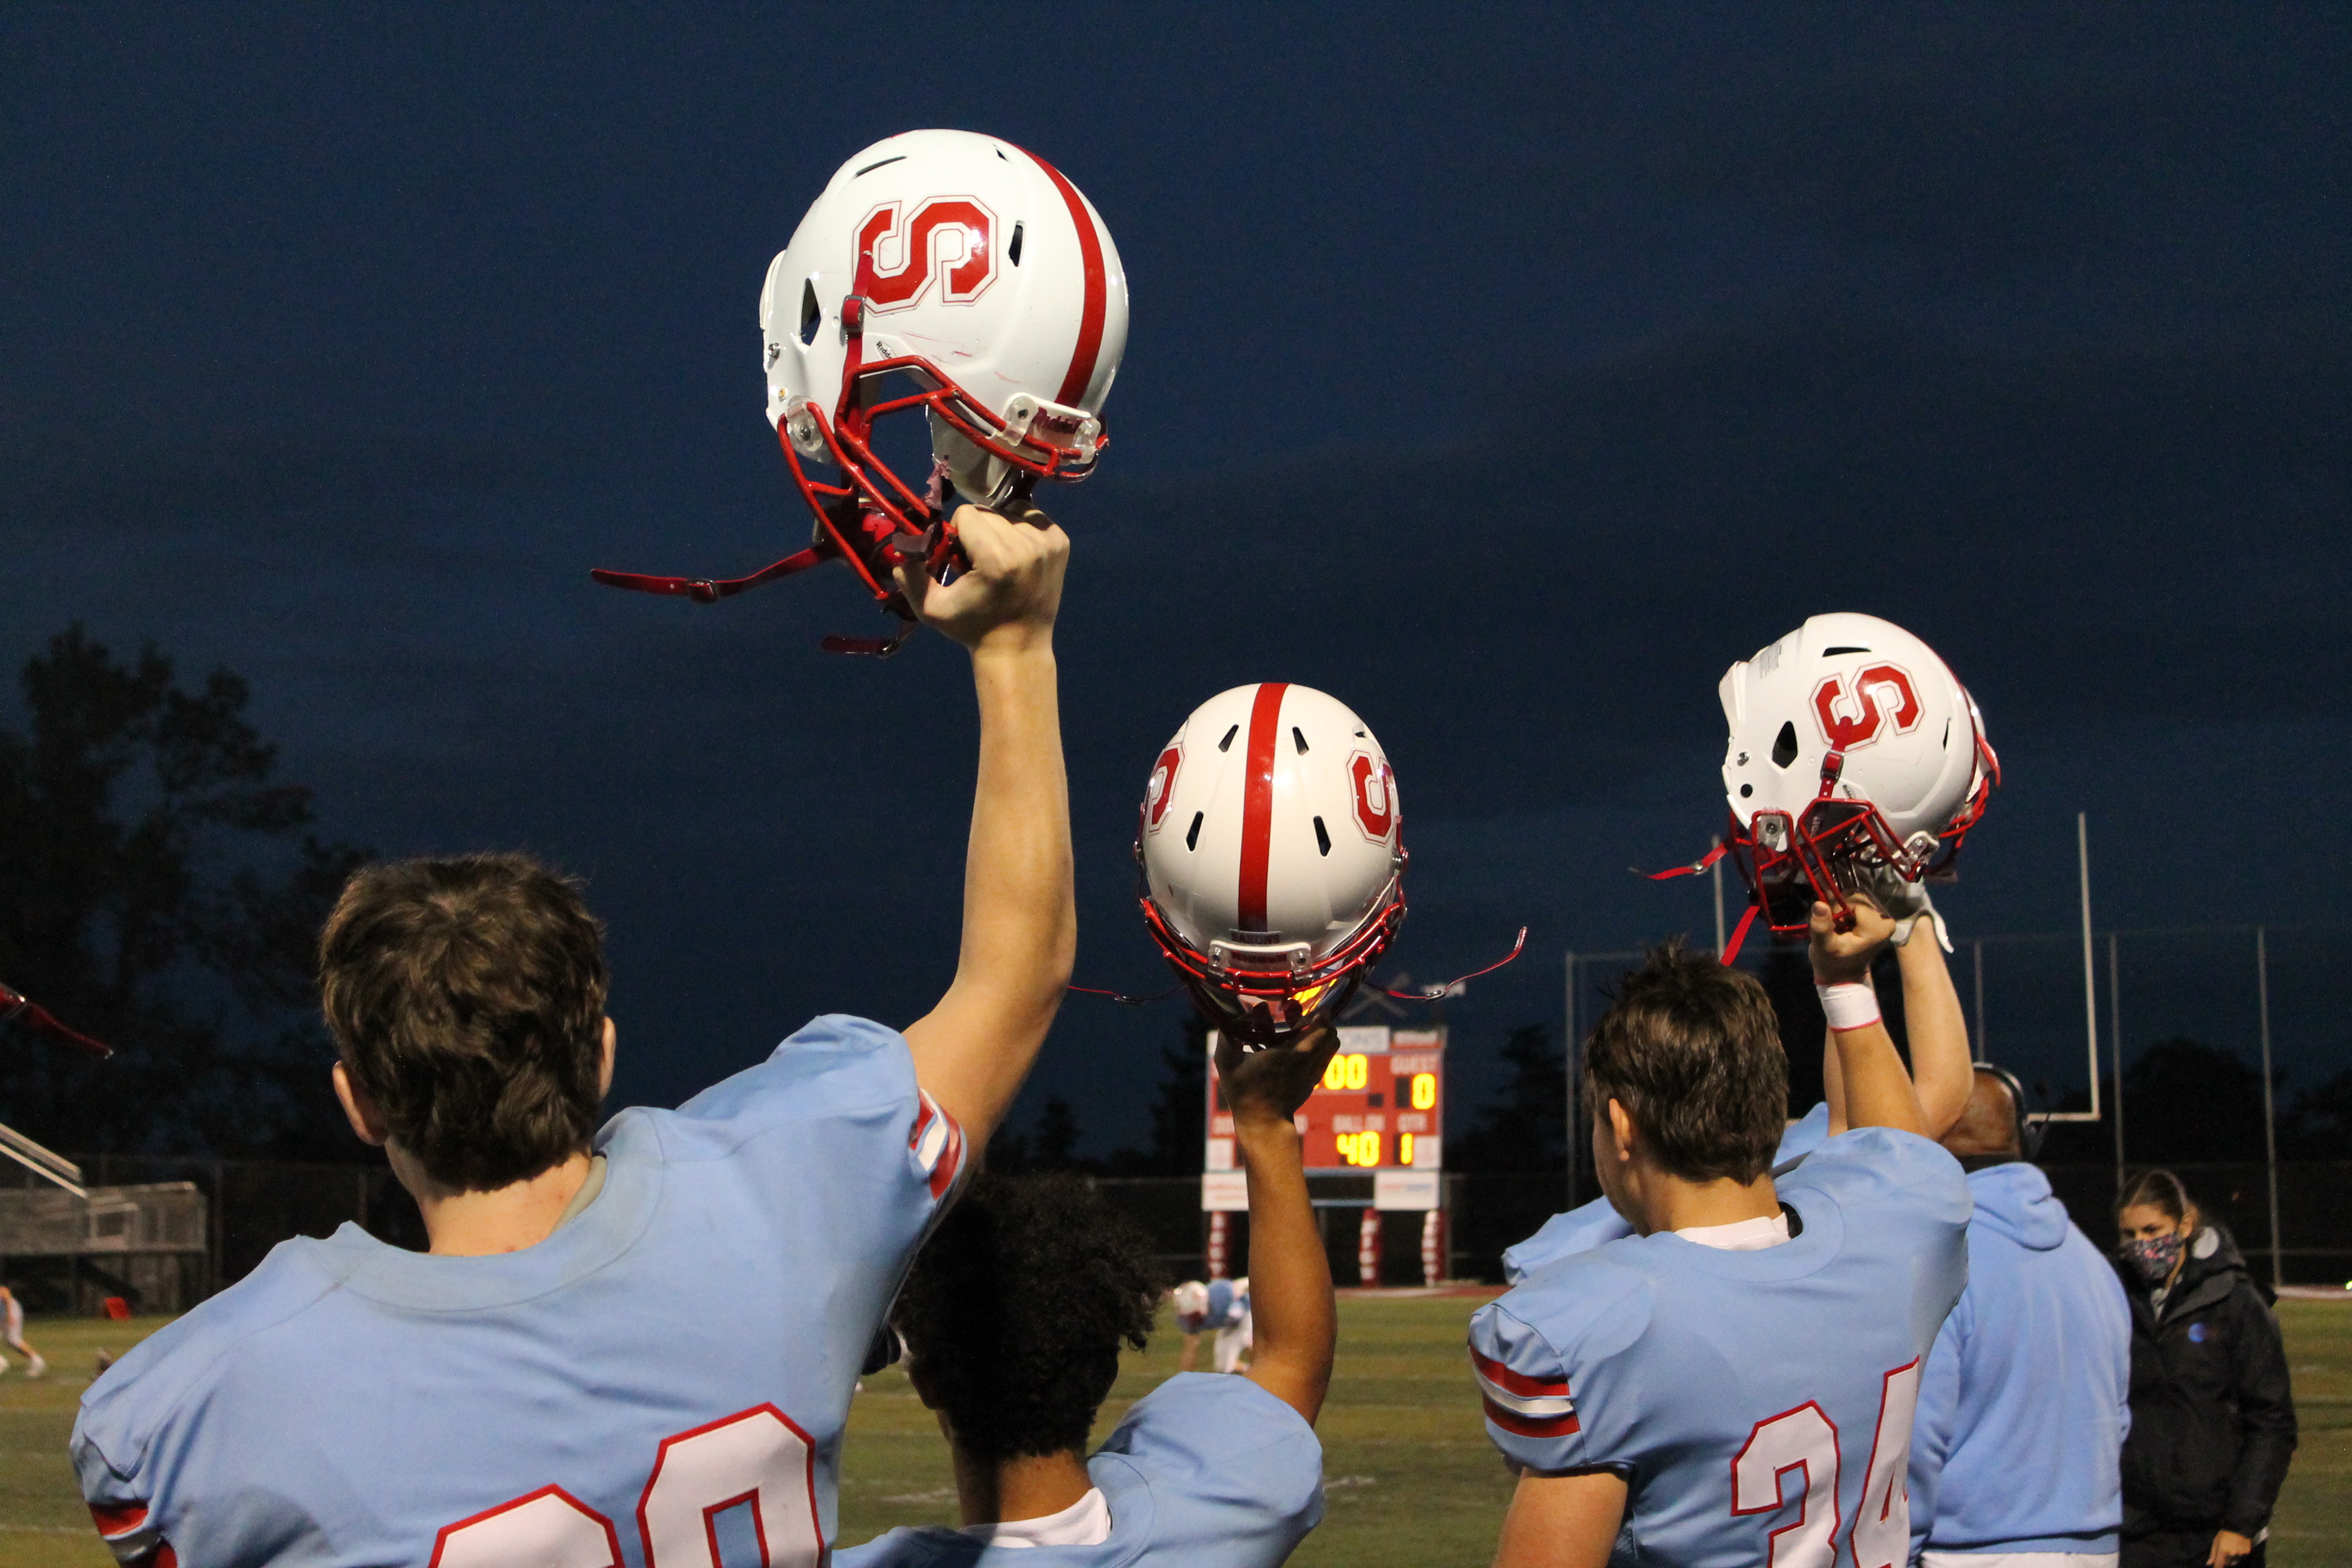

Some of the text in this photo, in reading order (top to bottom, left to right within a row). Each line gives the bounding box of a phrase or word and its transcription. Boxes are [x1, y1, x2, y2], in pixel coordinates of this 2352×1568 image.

[852, 195, 998, 317] S
[1808, 661, 1925, 752] S
[1412, 1073, 1435, 1110] 0
[1337, 1131, 1380, 1167] 40
[1401, 1133, 1413, 1164] 1
